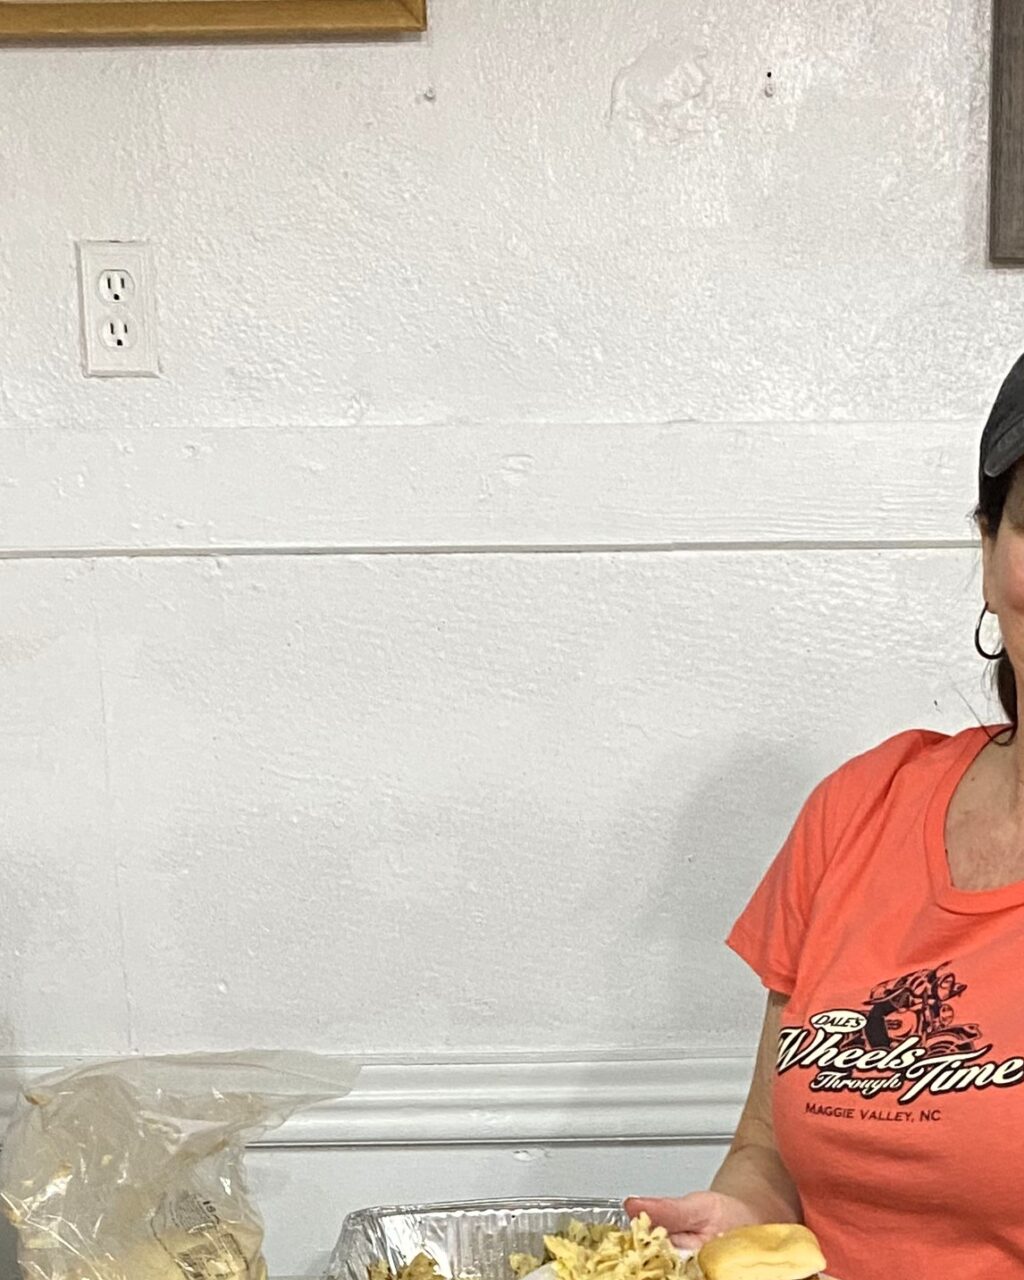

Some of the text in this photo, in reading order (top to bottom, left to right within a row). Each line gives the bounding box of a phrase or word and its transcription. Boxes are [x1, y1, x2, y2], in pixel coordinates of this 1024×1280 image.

[813, 1013, 864, 1029] DALE'S
[777, 1027, 927, 1074] Wheels
[809, 1070, 903, 1097] Through
[805, 1102, 941, 1123] MAGGIE VALLEY, NC
